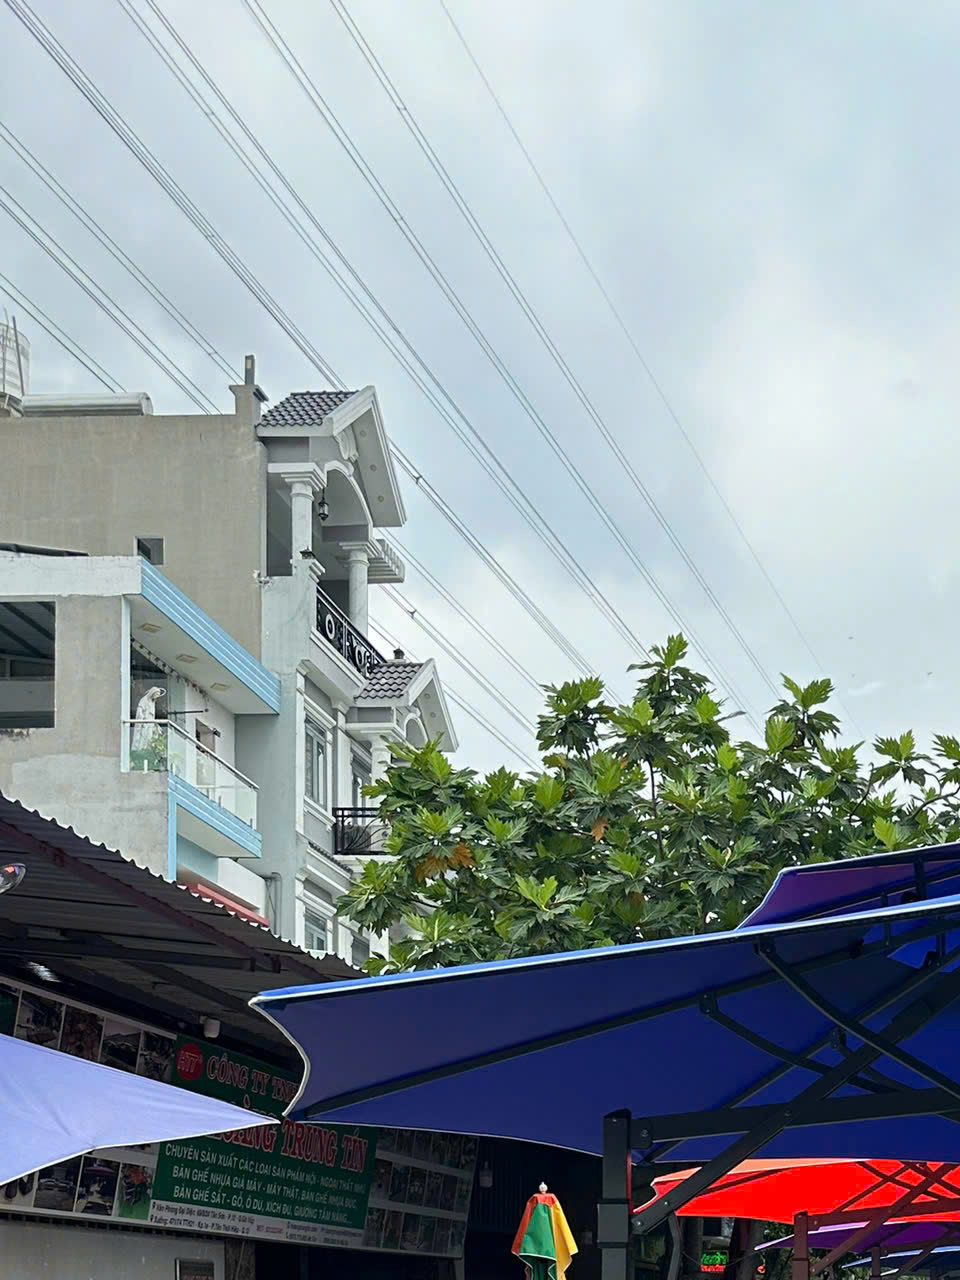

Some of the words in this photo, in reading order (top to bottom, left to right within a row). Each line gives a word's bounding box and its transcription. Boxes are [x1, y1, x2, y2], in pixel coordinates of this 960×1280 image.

[207, 1053, 249, 1089] CÔNG
[251, 1068, 271, 1096] TY
[165, 1143, 199, 1161] CHUYÊN
[281, 1119, 338, 1168] TRUNG
[191, 1166, 210, 1183] GHẾ
[192, 1186, 210, 1202] GHẾ
